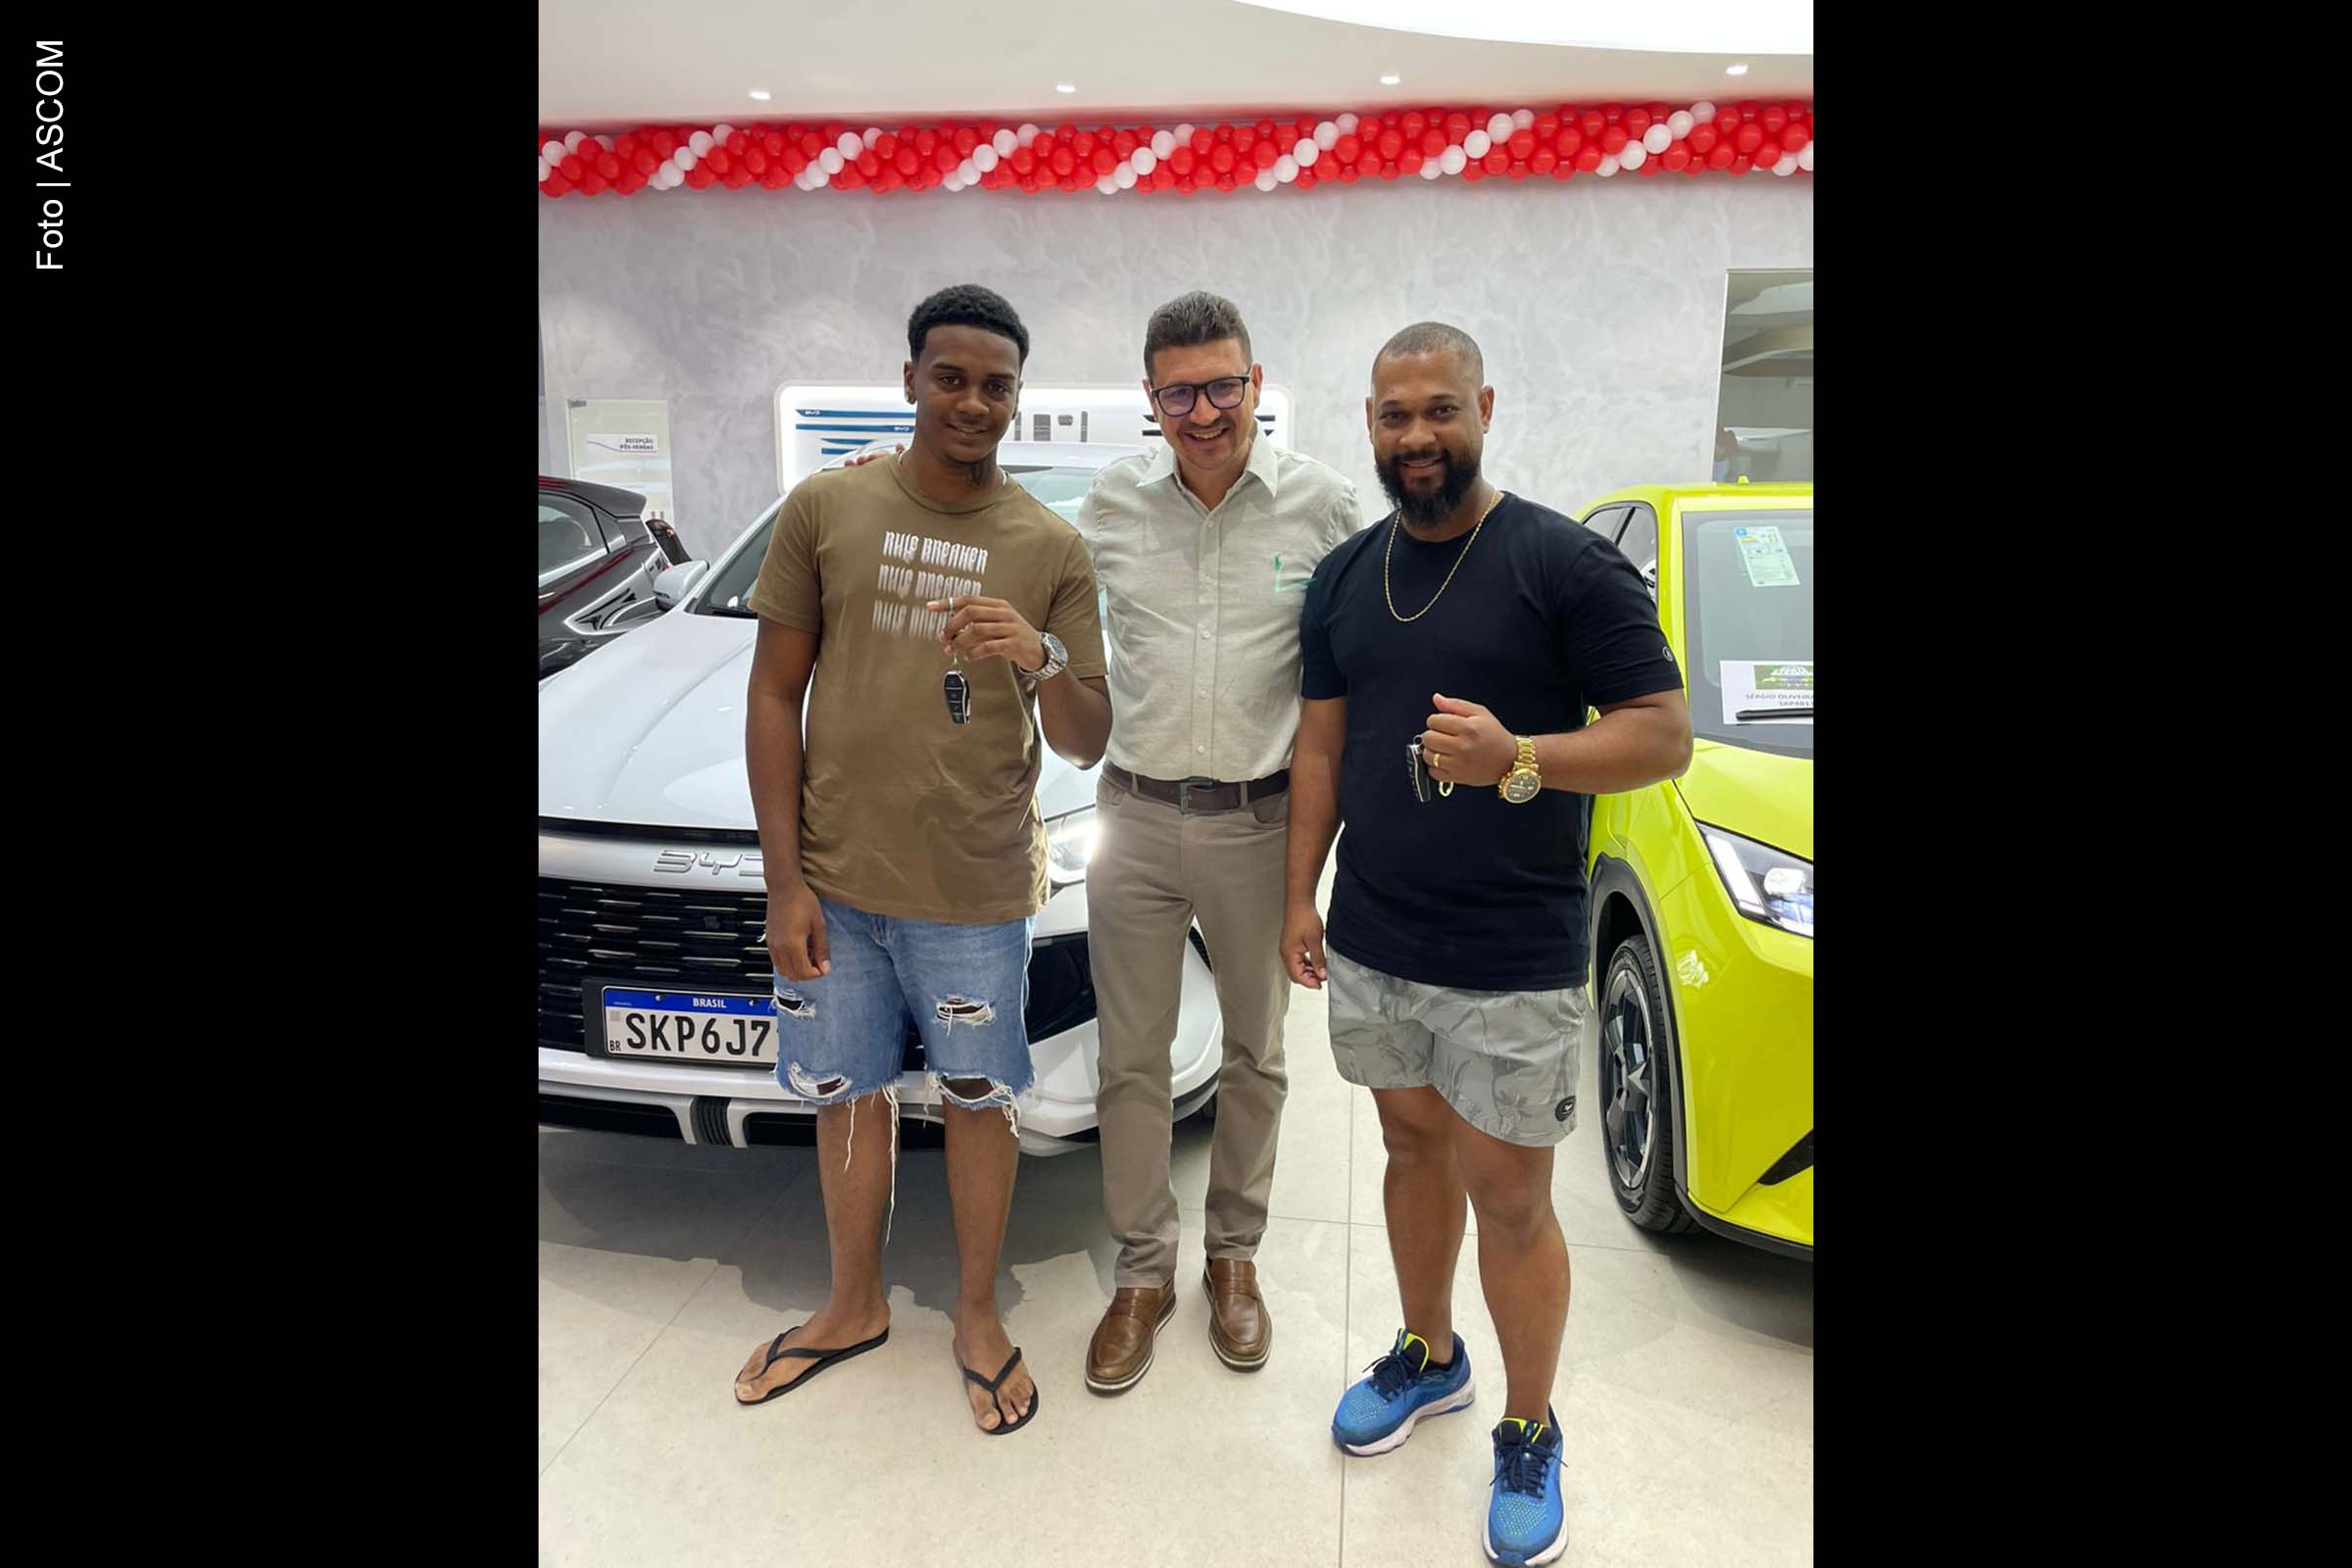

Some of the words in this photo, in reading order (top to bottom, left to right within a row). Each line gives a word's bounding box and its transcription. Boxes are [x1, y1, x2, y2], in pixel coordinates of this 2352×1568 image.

[693, 998, 727, 1009] BRASIL
[625, 1012, 779, 1057] SKP6J7
[610, 1040, 621, 1052] BR
